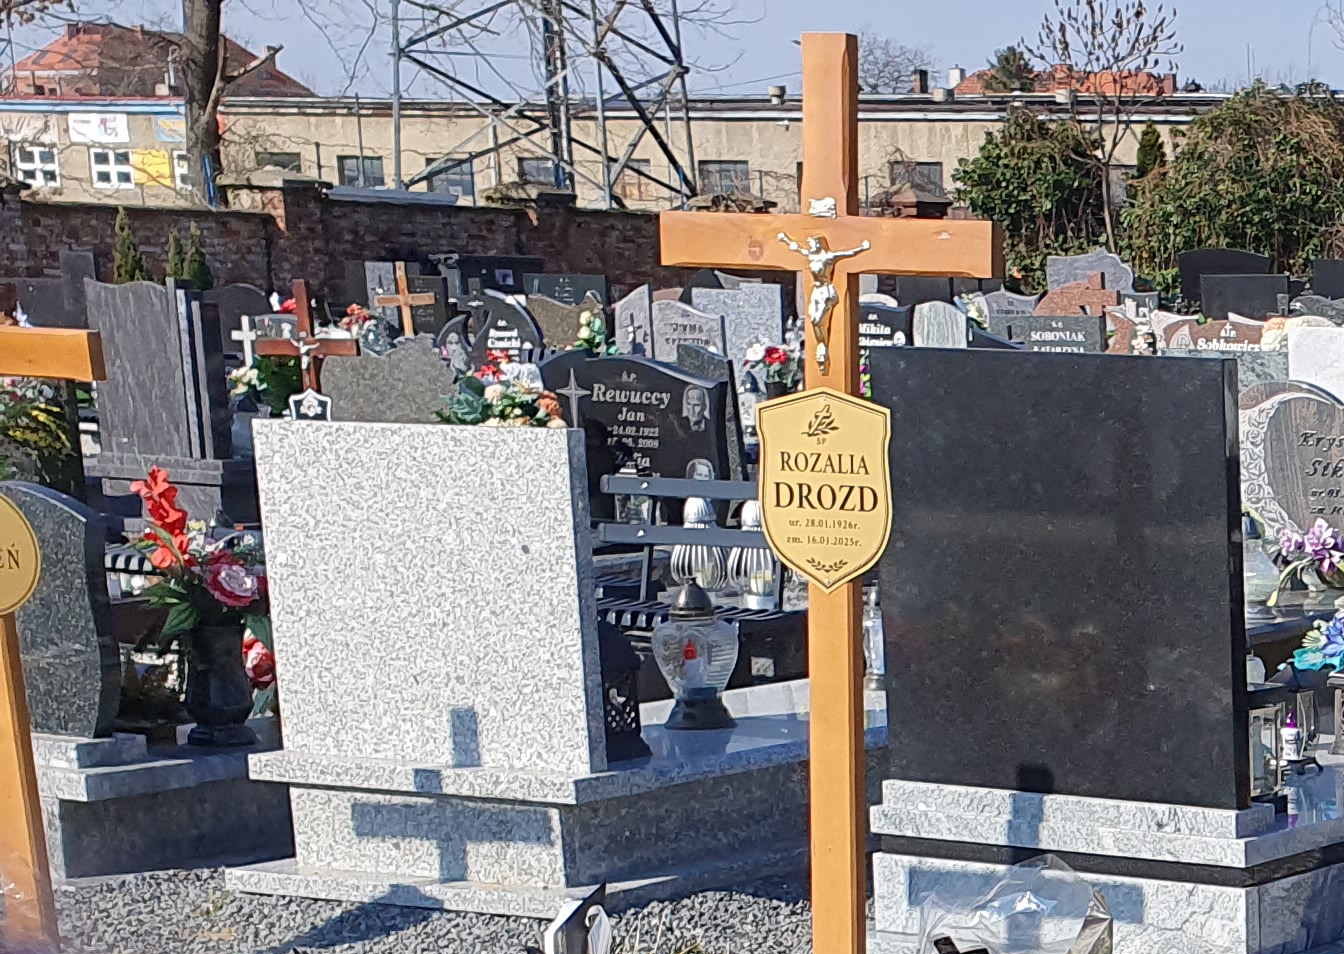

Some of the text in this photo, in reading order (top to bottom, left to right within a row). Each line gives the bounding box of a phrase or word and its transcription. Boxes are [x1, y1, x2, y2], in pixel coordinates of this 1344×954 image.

[591, 384, 671, 408] Rewuccy
[618, 407, 645, 422] Jan
[780, 451, 870, 475] ROZALIA
[773, 482, 878, 512] DROZD
